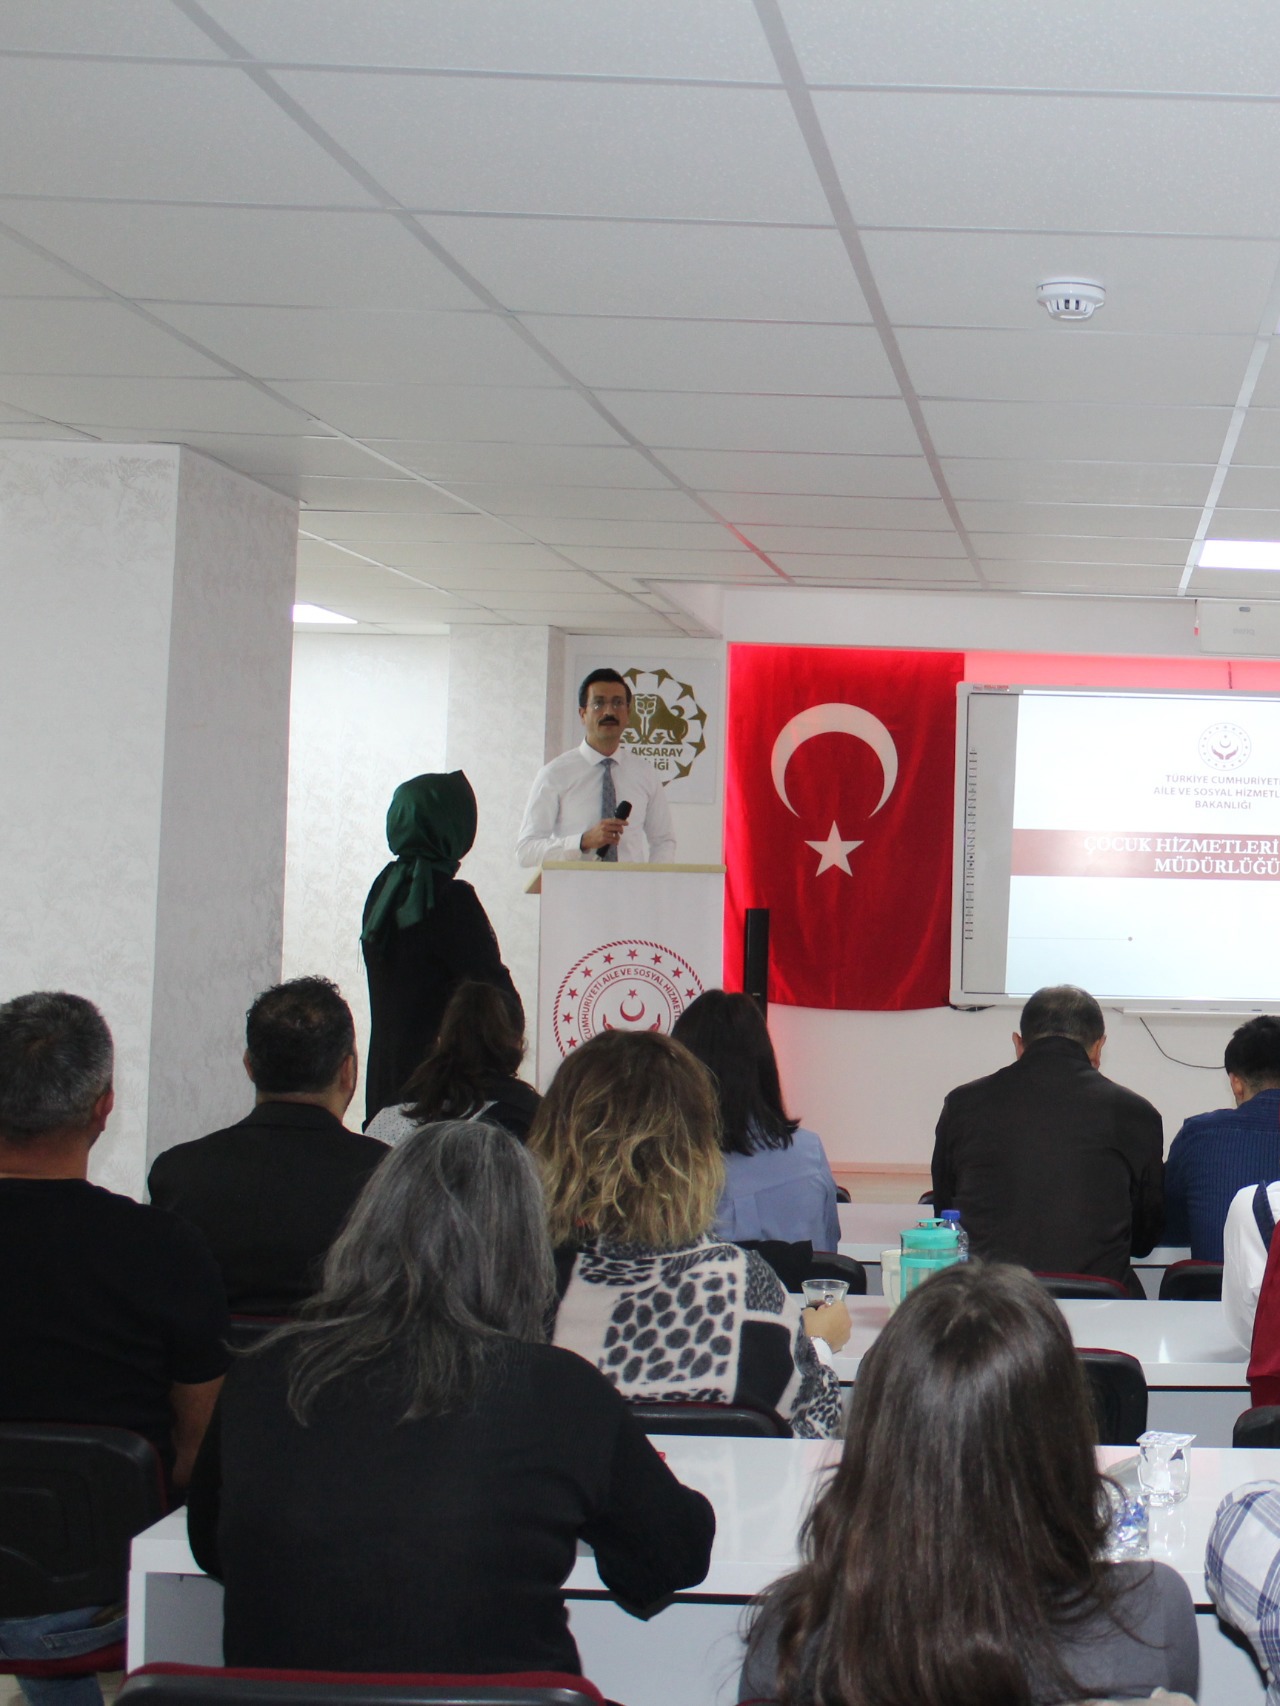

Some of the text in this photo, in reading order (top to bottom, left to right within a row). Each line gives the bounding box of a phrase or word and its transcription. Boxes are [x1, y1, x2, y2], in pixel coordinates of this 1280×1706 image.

[631, 747, 683, 757] AKSARAY
[1165, 774, 1208, 784] TÜRKİYE
[1154, 787, 1176, 795] AİLE
[1194, 788, 1233, 797] SOSYAL
[1195, 800, 1251, 810] BAKANLIĞI
[1084, 836, 1152, 855] ÇOCUK
[1155, 836, 1279, 855] HİZMETLERİ
[1154, 856, 1280, 875] MÜDÜRLÜĞÜ
[602, 970, 620, 985] AİLE
[620, 968, 632, 976] VE
[634, 968, 663, 986] SOSYAL
[663, 983, 681, 1020] HİZMETL
